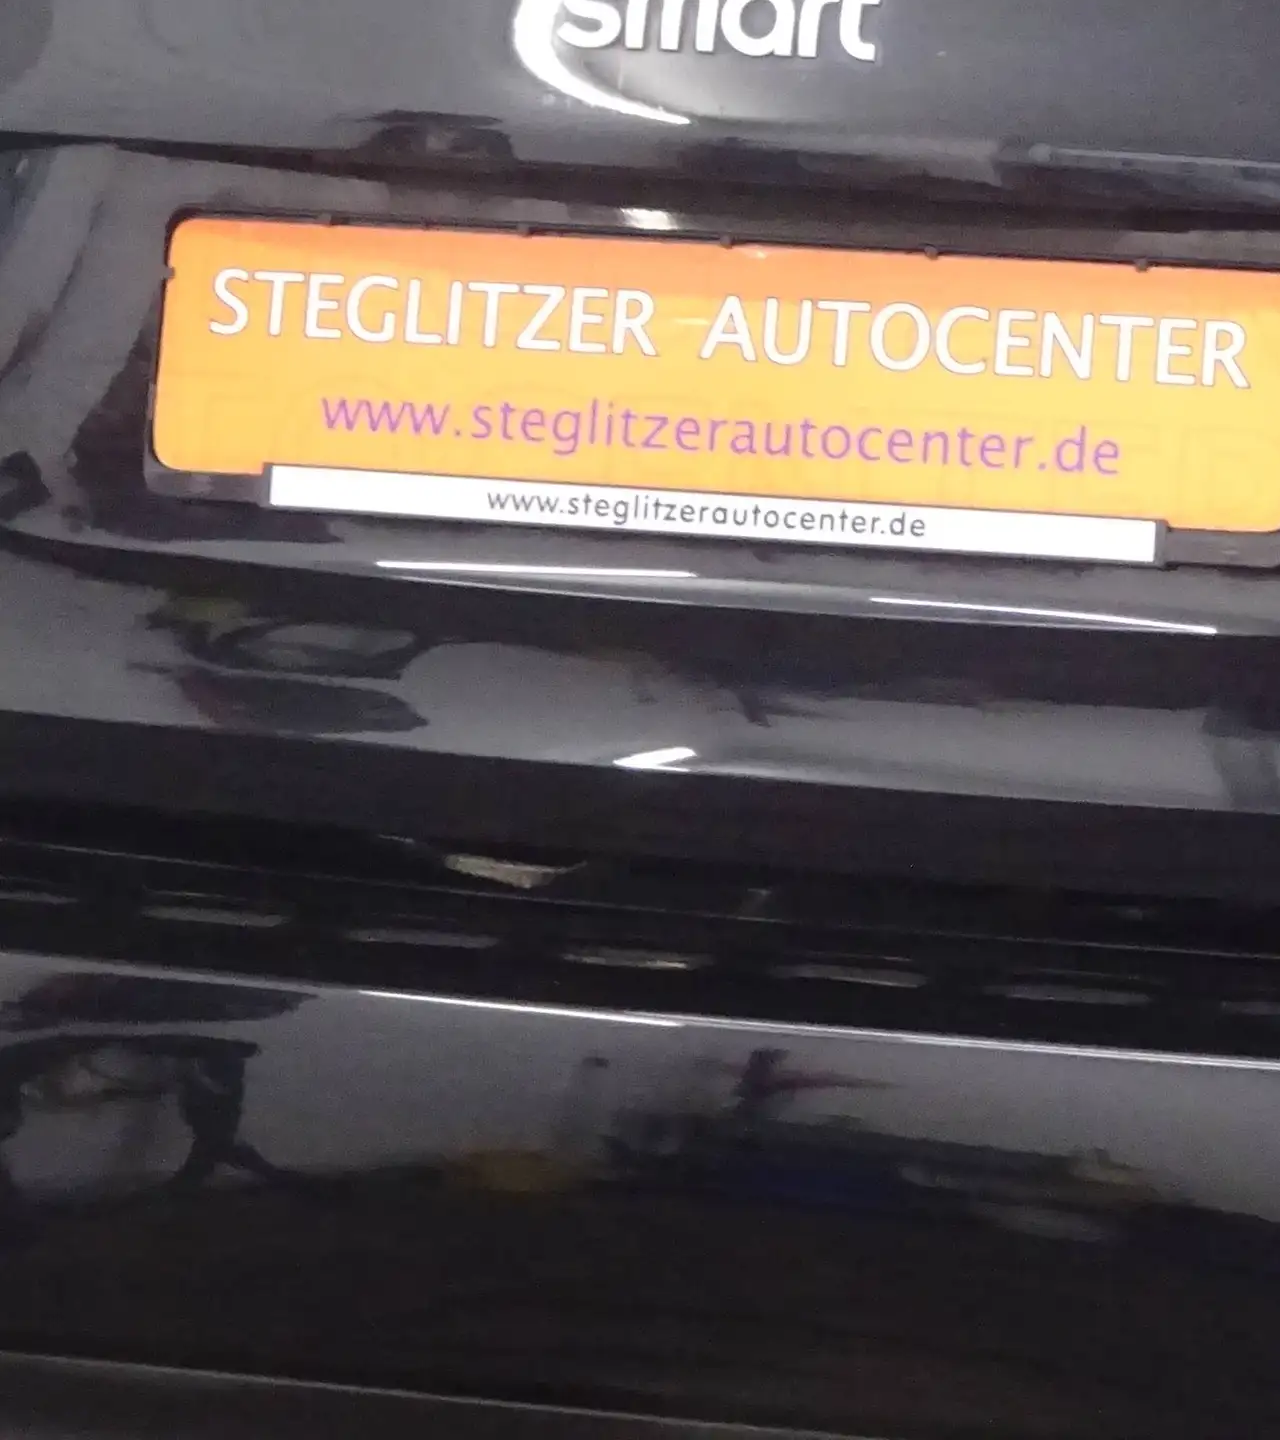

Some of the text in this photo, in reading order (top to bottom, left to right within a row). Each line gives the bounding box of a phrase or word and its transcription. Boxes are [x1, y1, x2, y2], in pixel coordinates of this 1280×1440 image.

[208, 267, 1251, 389] STEGLITZER AUTOCENTER
[321, 397, 1121, 475] www.steglitzerautocenter.de
[486, 488, 927, 539] www.steglitzerautocenter.de
